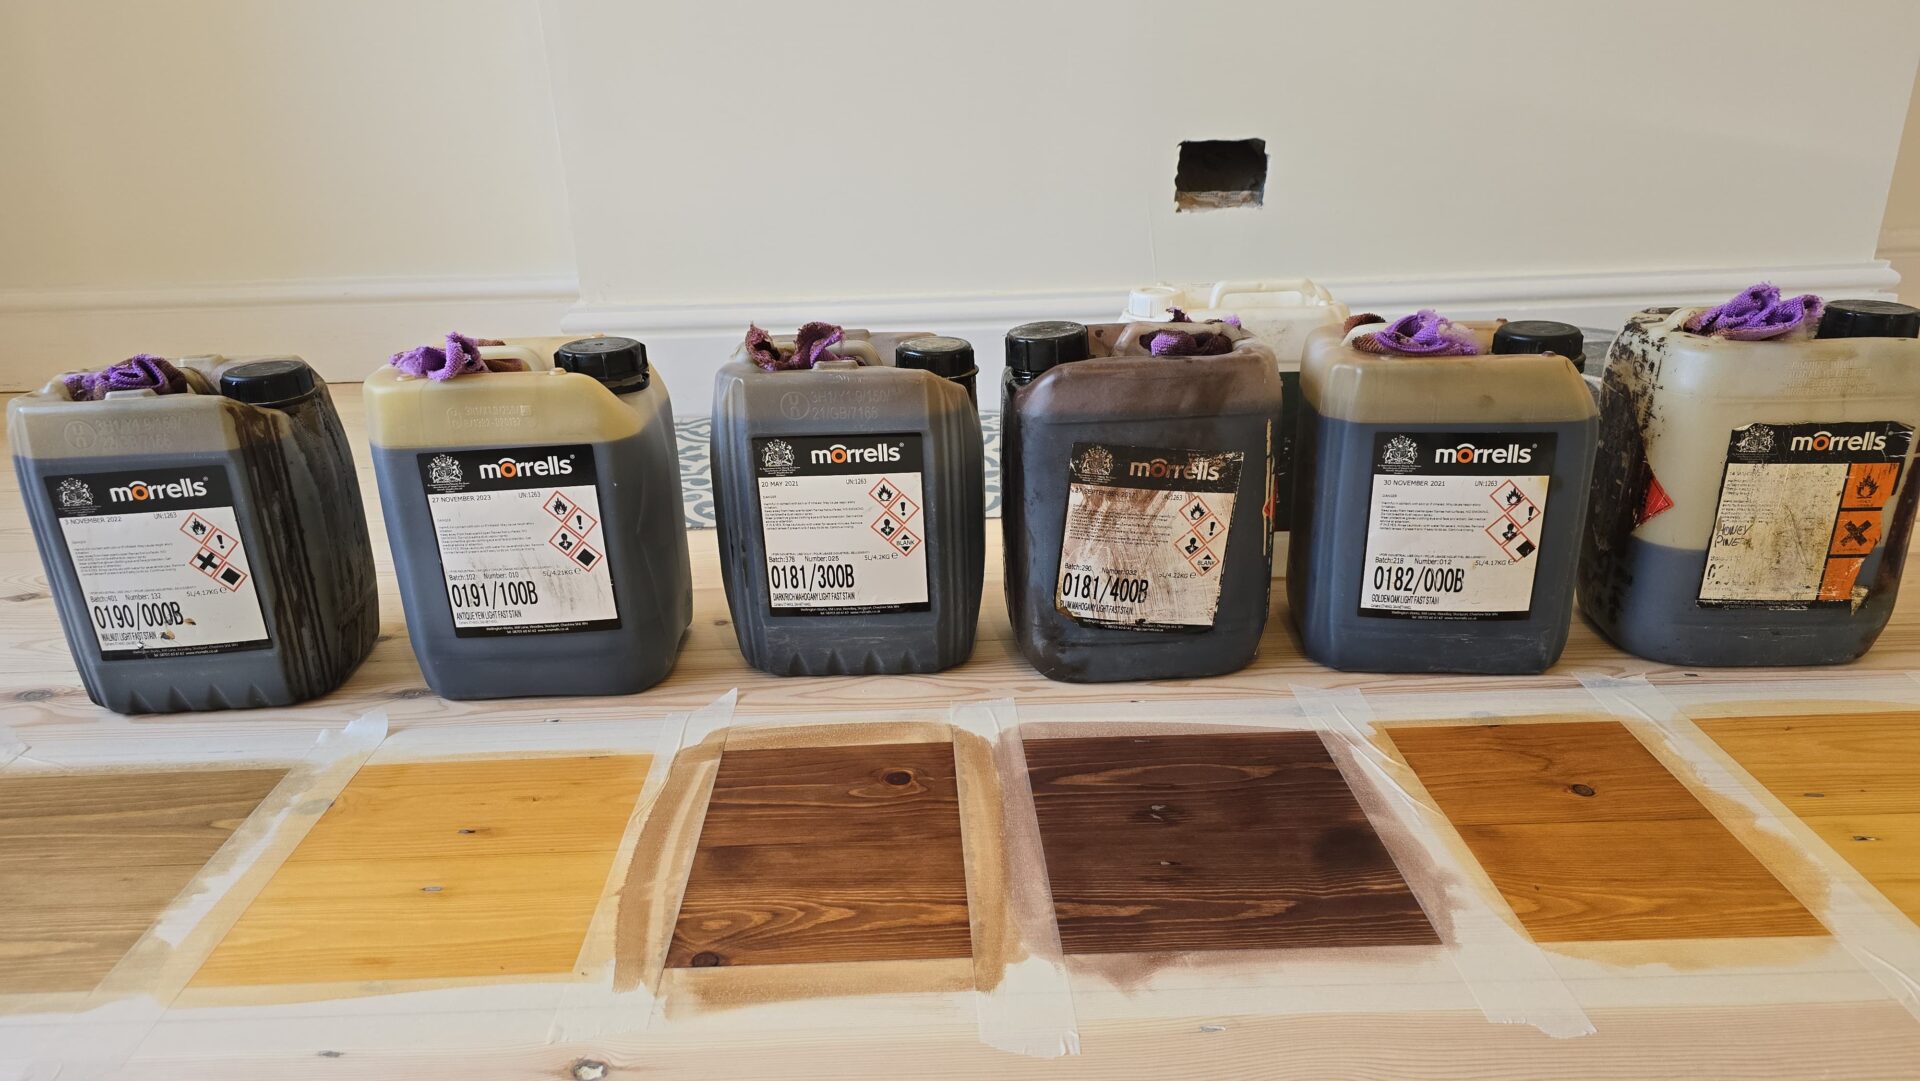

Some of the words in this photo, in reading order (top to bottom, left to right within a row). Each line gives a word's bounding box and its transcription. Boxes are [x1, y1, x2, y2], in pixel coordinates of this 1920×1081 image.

[1790, 431, 1886, 451] morrells
[811, 444, 900, 464] morrells
[1434, 443, 1532, 464] morrells
[479, 456, 572, 479] morrells
[1130, 458, 1220, 481] morrells
[109, 478, 207, 502] morrells
[70, 517, 105, 525] NOVEMBER
[1714, 536, 1745, 547] PINE
[772, 564, 854, 591] 0181/300B
[1063, 573, 1149, 603] 0181/400B
[1374, 566, 1464, 595] 0182/000B
[452, 581, 538, 609] 0191/100B
[1372, 594, 1390, 602] GOLDEN
[1391, 595, 1400, 603] OAK
[1400, 595, 1413, 603] LIGHT
[1414, 596, 1425, 604] FAST
[94, 602, 184, 630] 0190/000B
[485, 611, 497, 619] LIGHT
[1109, 605, 1120, 613] FAST
[132, 632, 143, 640] FAST
[144, 631, 156, 639] STAIN
